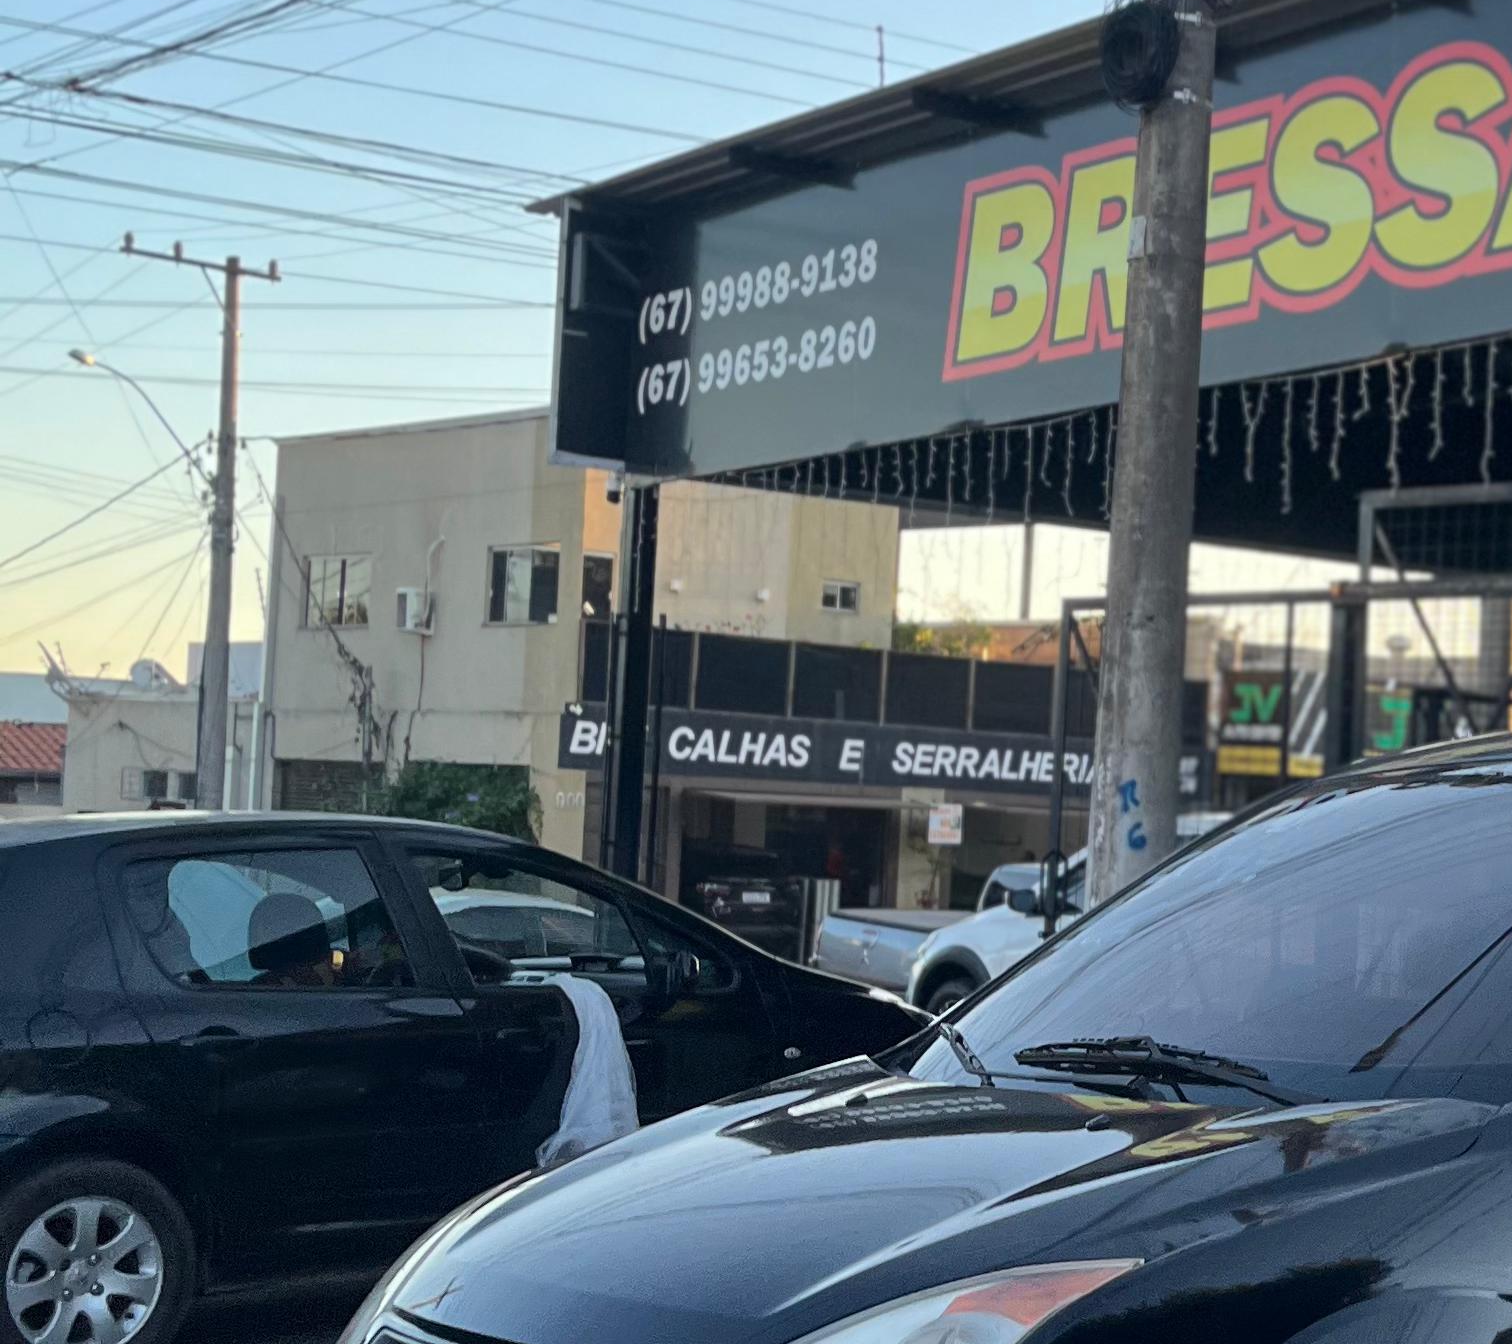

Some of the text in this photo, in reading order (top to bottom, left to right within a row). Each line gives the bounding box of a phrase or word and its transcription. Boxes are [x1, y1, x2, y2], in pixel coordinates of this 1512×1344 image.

[639, 238, 878, 345] (67) 99988-9138
[637, 315, 876, 416] (67) 99653-8260
[668, 726, 811, 768] CALHAS
[838, 738, 865, 771] E
